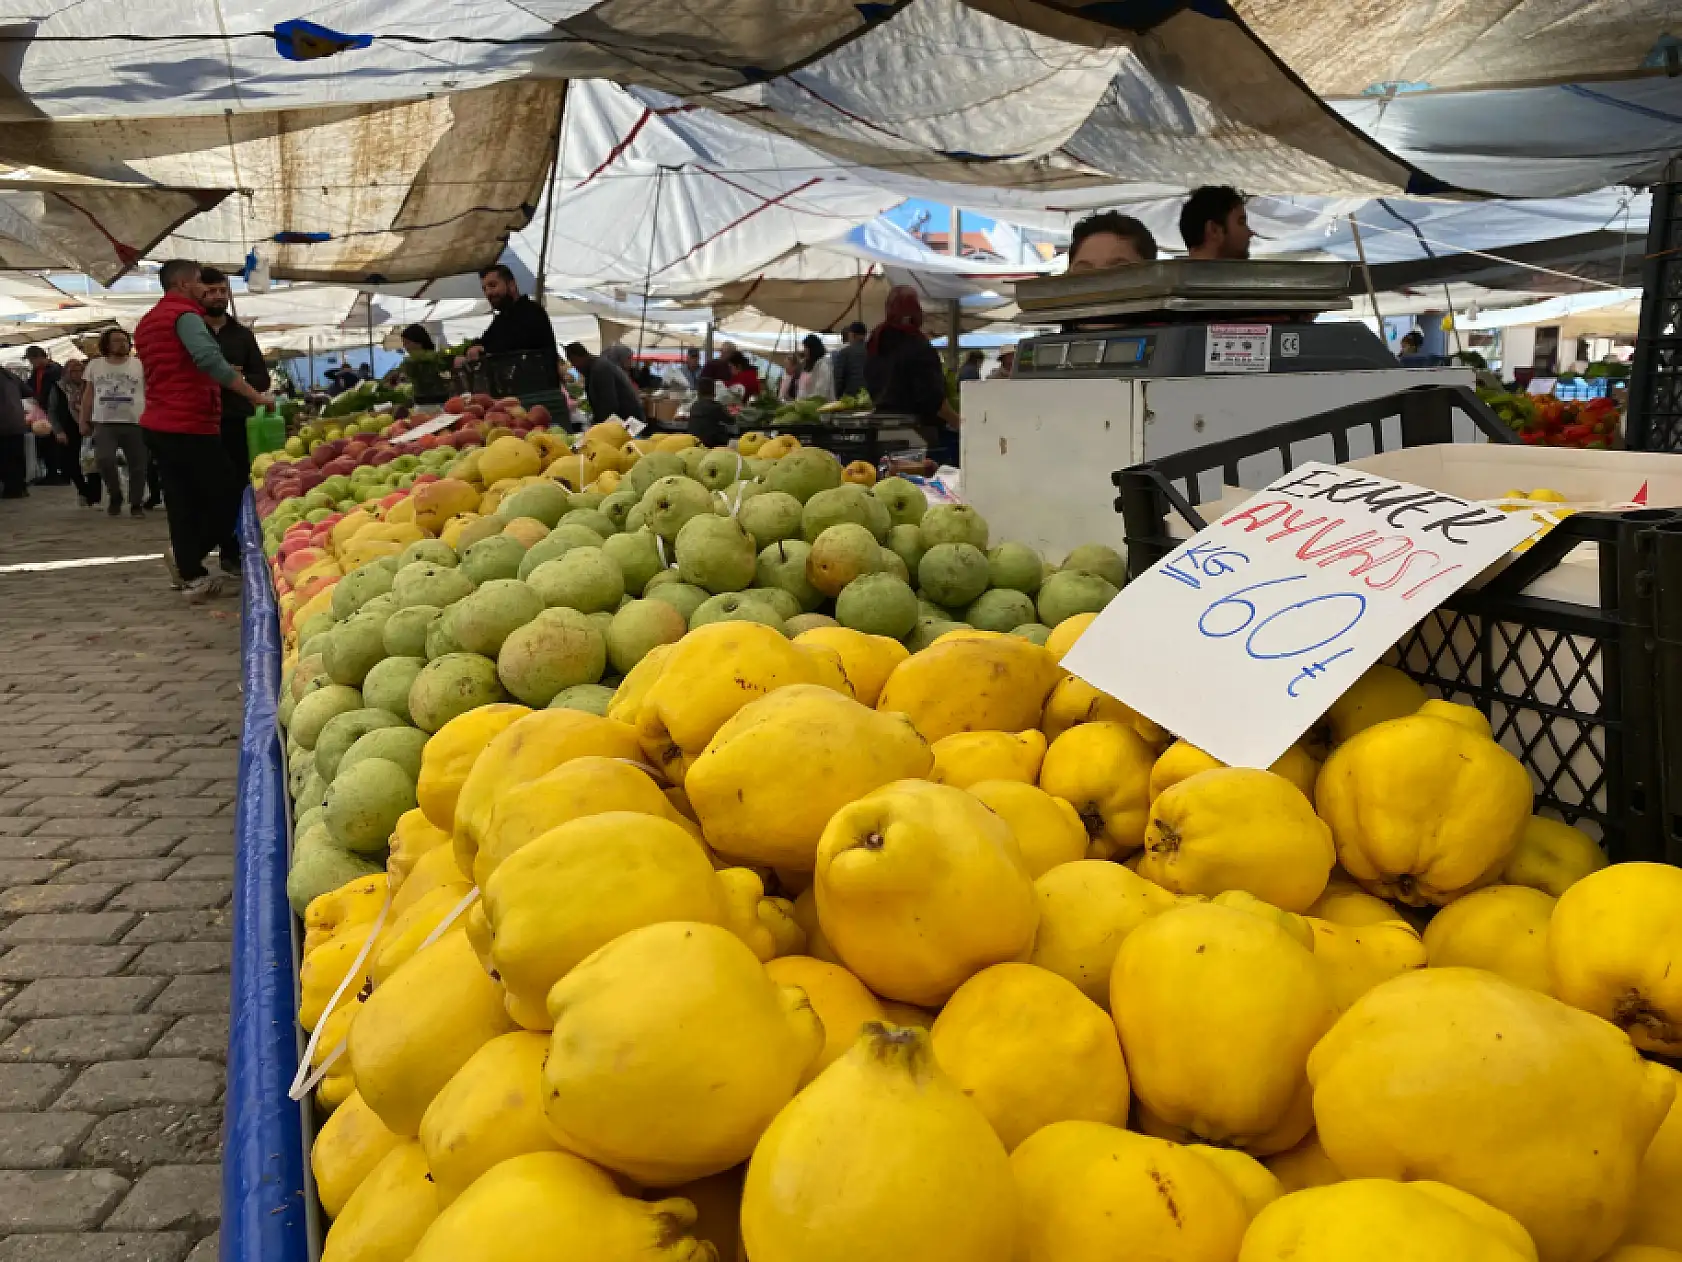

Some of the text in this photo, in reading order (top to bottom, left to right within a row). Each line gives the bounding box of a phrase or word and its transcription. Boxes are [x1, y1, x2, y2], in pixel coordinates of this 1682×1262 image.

[1282, 338, 1298, 353] CE
[1267, 470, 1507, 545] EKMEK
[1171, 541, 1250, 577] KG
[1221, 501, 1462, 600] AYVASI
